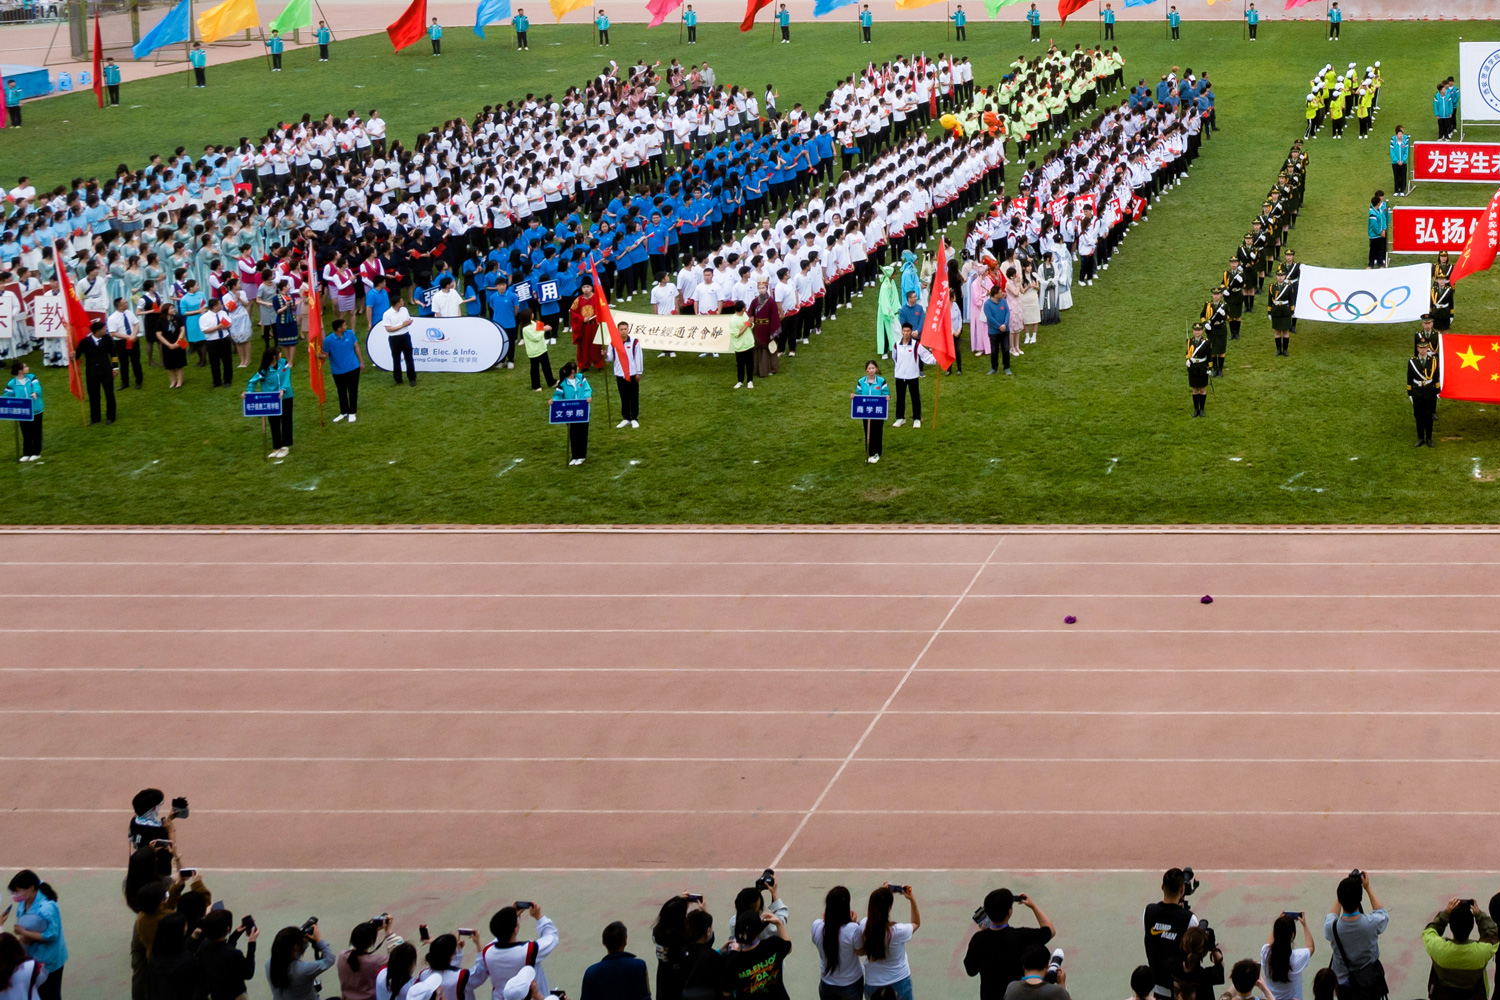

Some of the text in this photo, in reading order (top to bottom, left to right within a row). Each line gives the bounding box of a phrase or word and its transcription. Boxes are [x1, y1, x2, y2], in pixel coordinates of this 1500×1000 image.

[515, 282, 532, 301] 重
[541, 281, 558, 300] 用
[555, 409, 584, 418] 文学院
[856, 405, 883, 414] 商学院
[1160, 931, 1178, 940] MAN
